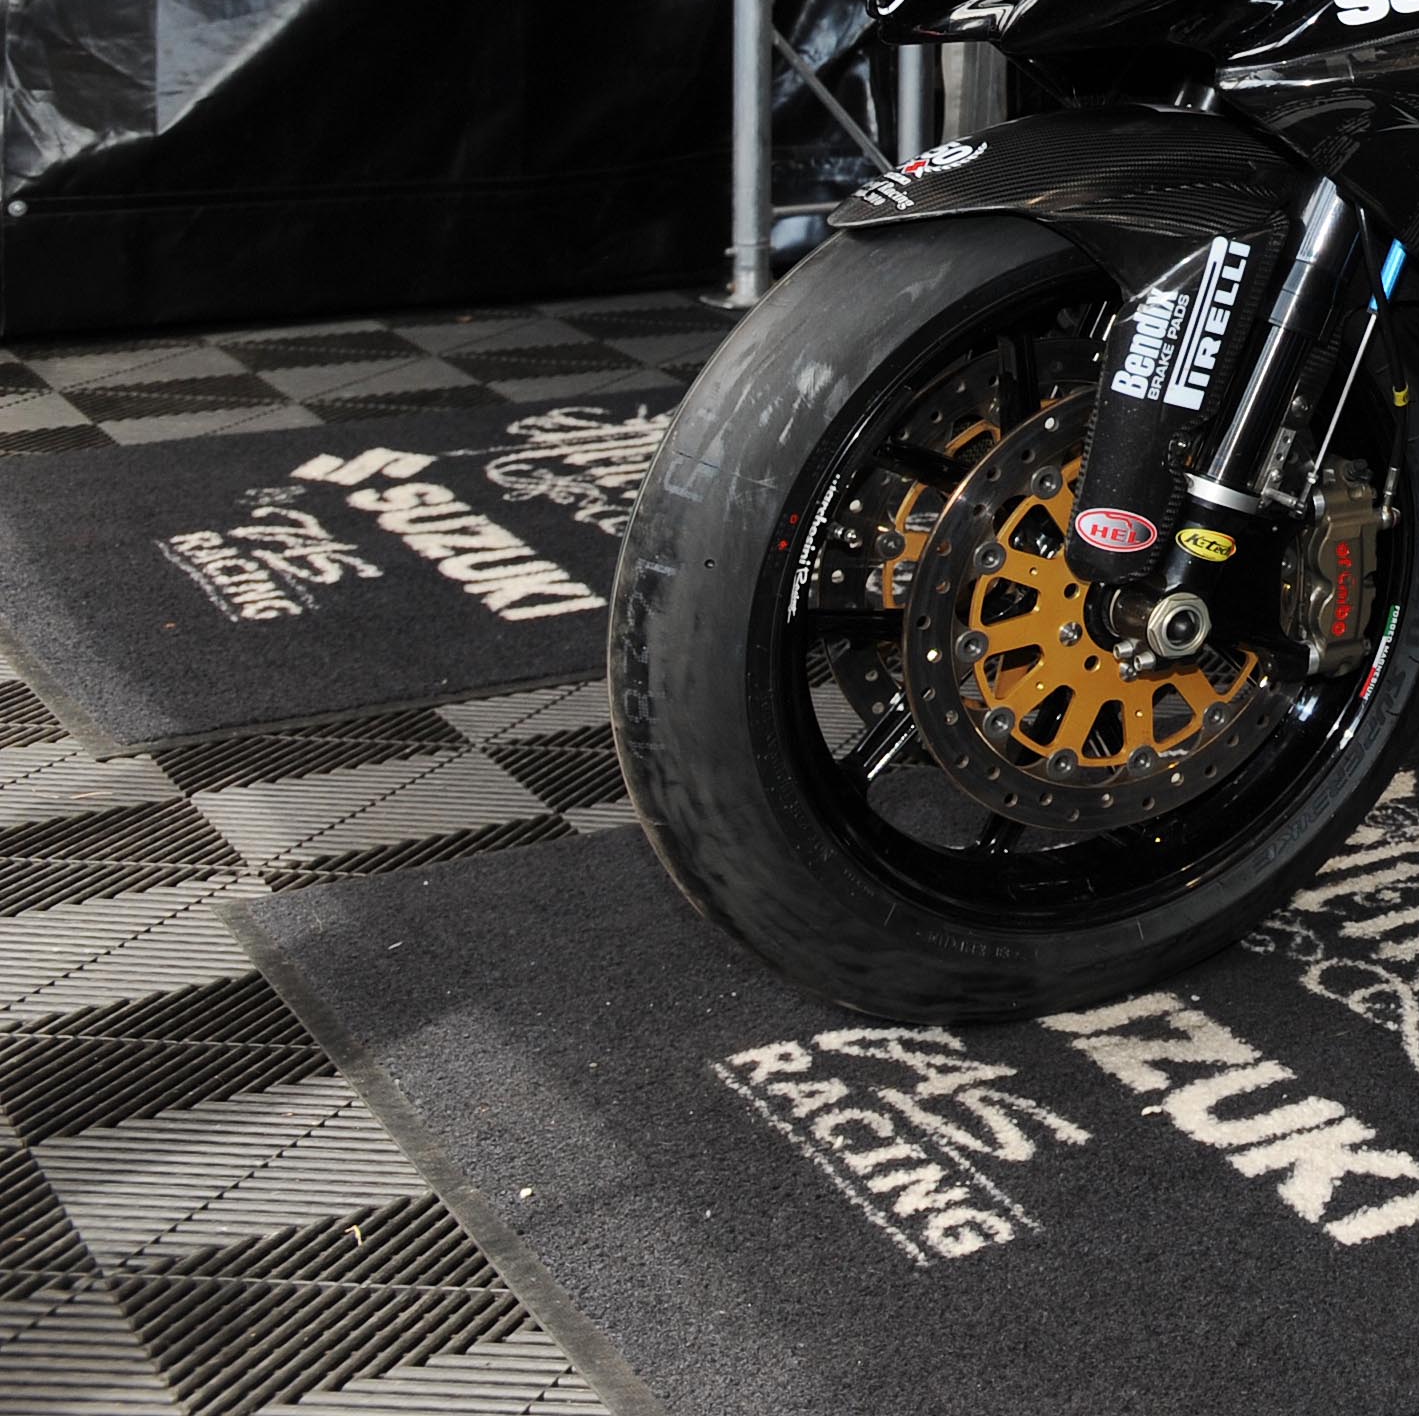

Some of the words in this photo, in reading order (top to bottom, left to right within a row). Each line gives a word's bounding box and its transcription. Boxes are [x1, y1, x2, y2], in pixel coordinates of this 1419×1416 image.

[1110, 286, 1180, 400] Bendix
[1146, 343, 1176, 401] BRAKE
[1167, 293, 1191, 341] PADS
[1162, 236, 1252, 412] PIRELLI
[346, 481, 608, 622] SUZUKI
[1089, 523, 1142, 545] HEL
[725, 1039, 1014, 1259] RACING
